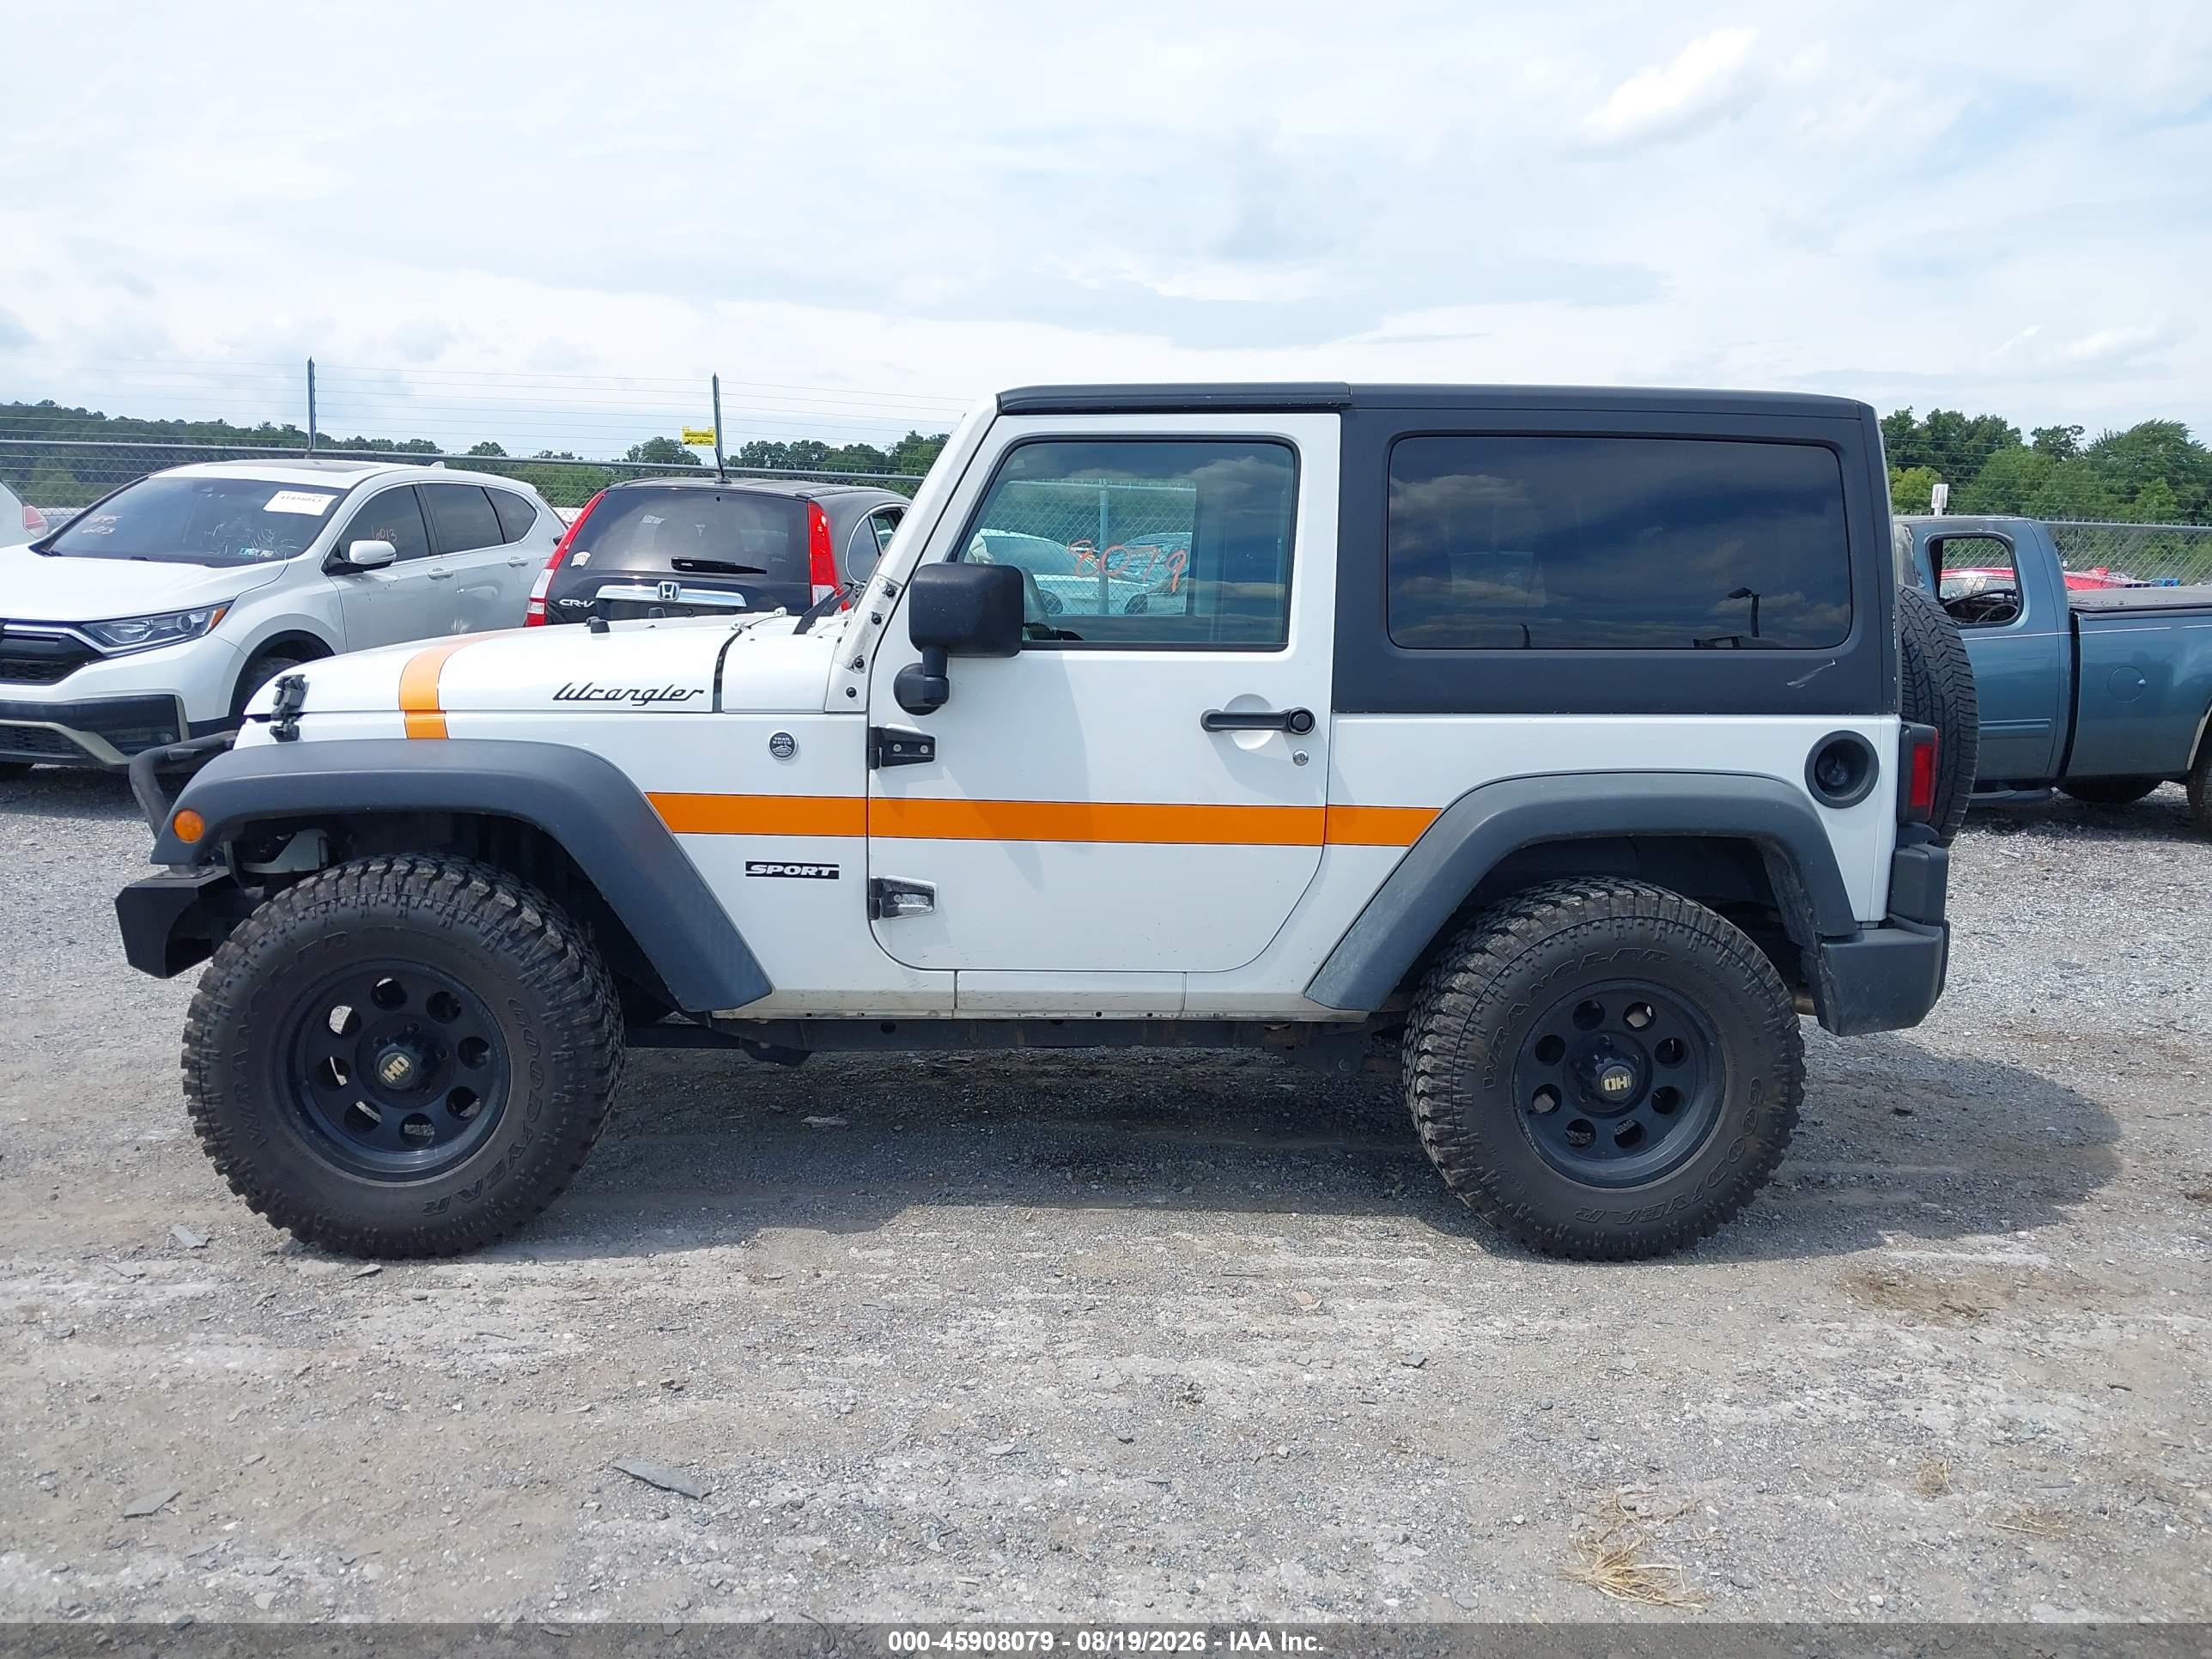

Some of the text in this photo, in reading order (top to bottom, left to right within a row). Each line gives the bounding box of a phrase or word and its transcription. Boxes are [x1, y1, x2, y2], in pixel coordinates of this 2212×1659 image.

[1068, 539, 1187, 592] 8079
[559, 599, 595, 608] CR-V
[552, 682, 705, 707] Wrangler
[745, 864, 840, 876] SPORT
[1483, 947, 1671, 1090] WRANGLER
[422, 997, 546, 1218] GOODYEAR
[1573, 1077, 1765, 1224] GOODYEAR
